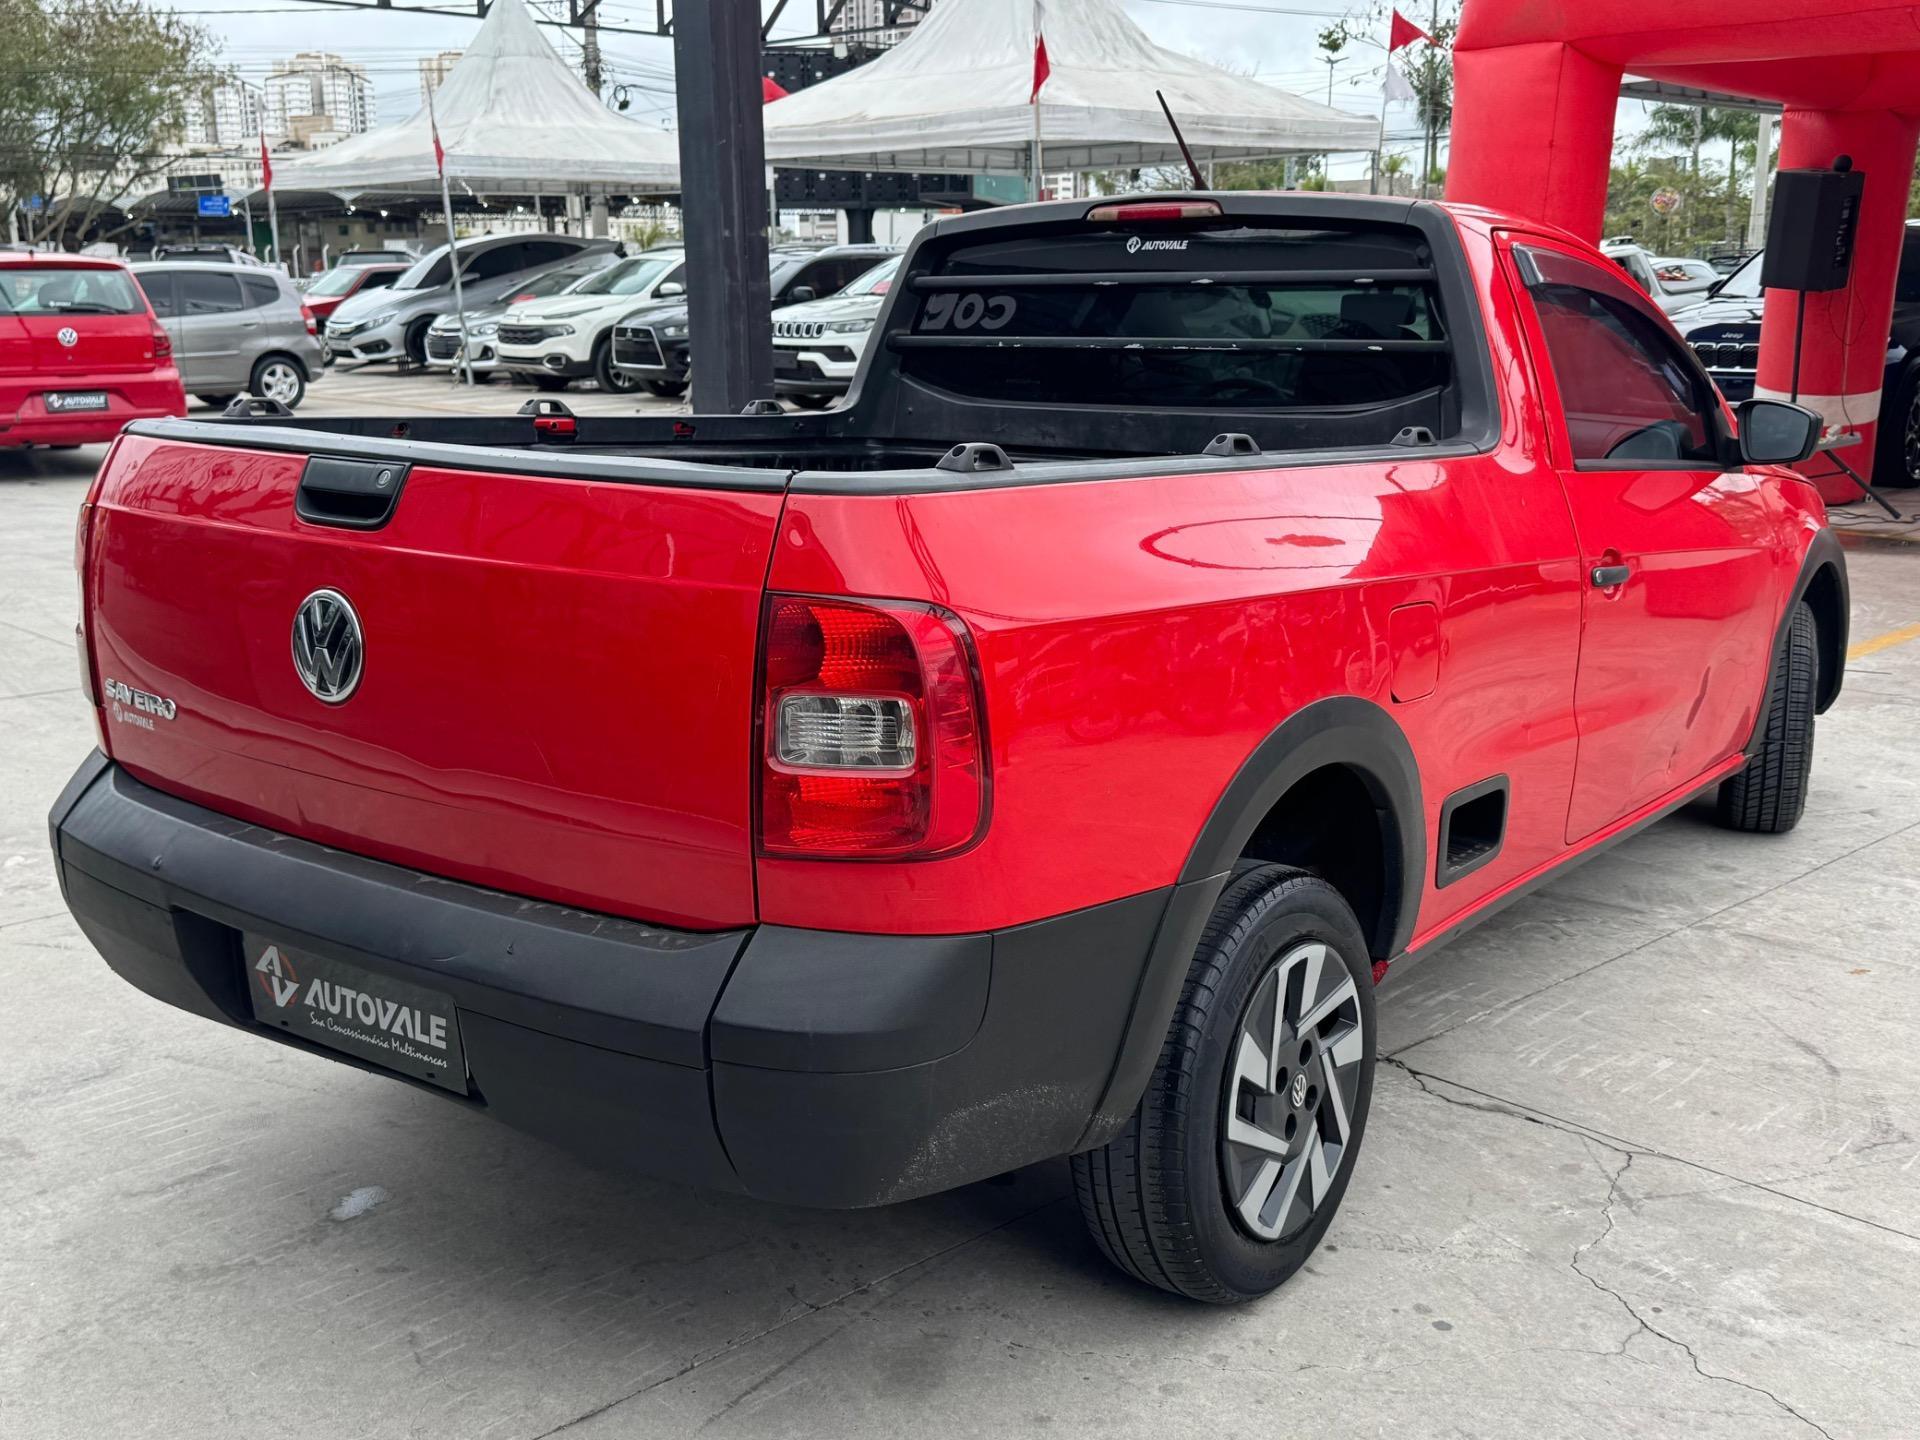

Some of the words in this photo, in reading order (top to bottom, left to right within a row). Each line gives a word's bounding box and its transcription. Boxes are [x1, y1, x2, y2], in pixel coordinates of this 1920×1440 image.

[1141, 240, 1188, 250] AUTOVALE
[64, 395, 106, 405] AUTOVALE
[105, 678, 177, 720] SAVEIRO
[304, 978, 447, 1049] AUTOVALE
[310, 1011, 325, 1027] Sua
[391, 1038, 447, 1068] Multimarcas
